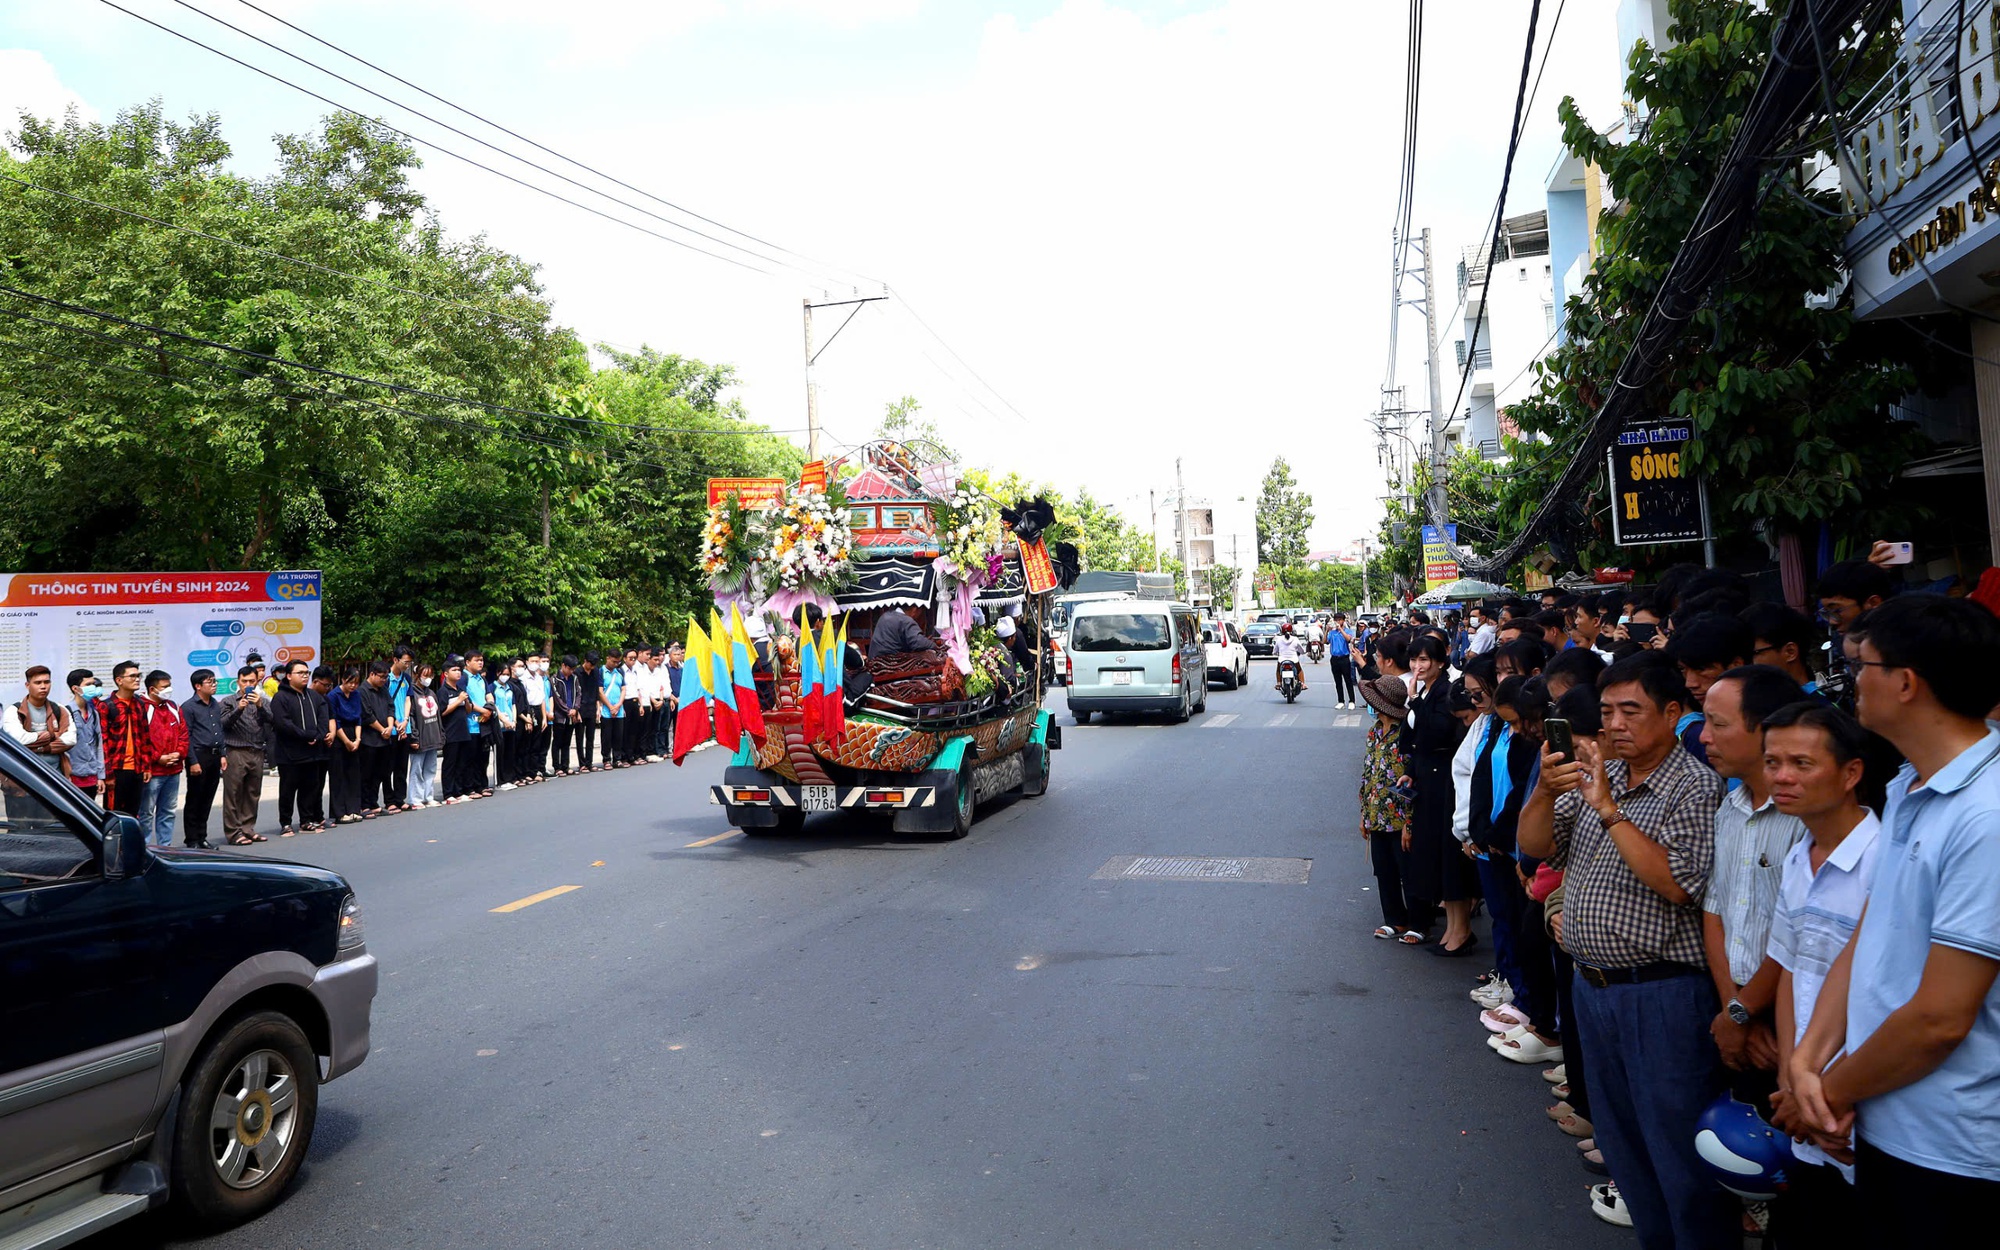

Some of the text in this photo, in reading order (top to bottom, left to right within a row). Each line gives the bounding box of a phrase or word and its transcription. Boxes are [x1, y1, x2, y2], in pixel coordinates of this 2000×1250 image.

[1618, 426, 1689, 445] NHÀ HÀNG
[1630, 446, 1680, 481] SÔNG
[28, 578, 250, 595] THÔNG TIN TUYỂN SINH 2024
[277, 583, 317, 600] QSA
[809, 786, 828, 798] 51B
